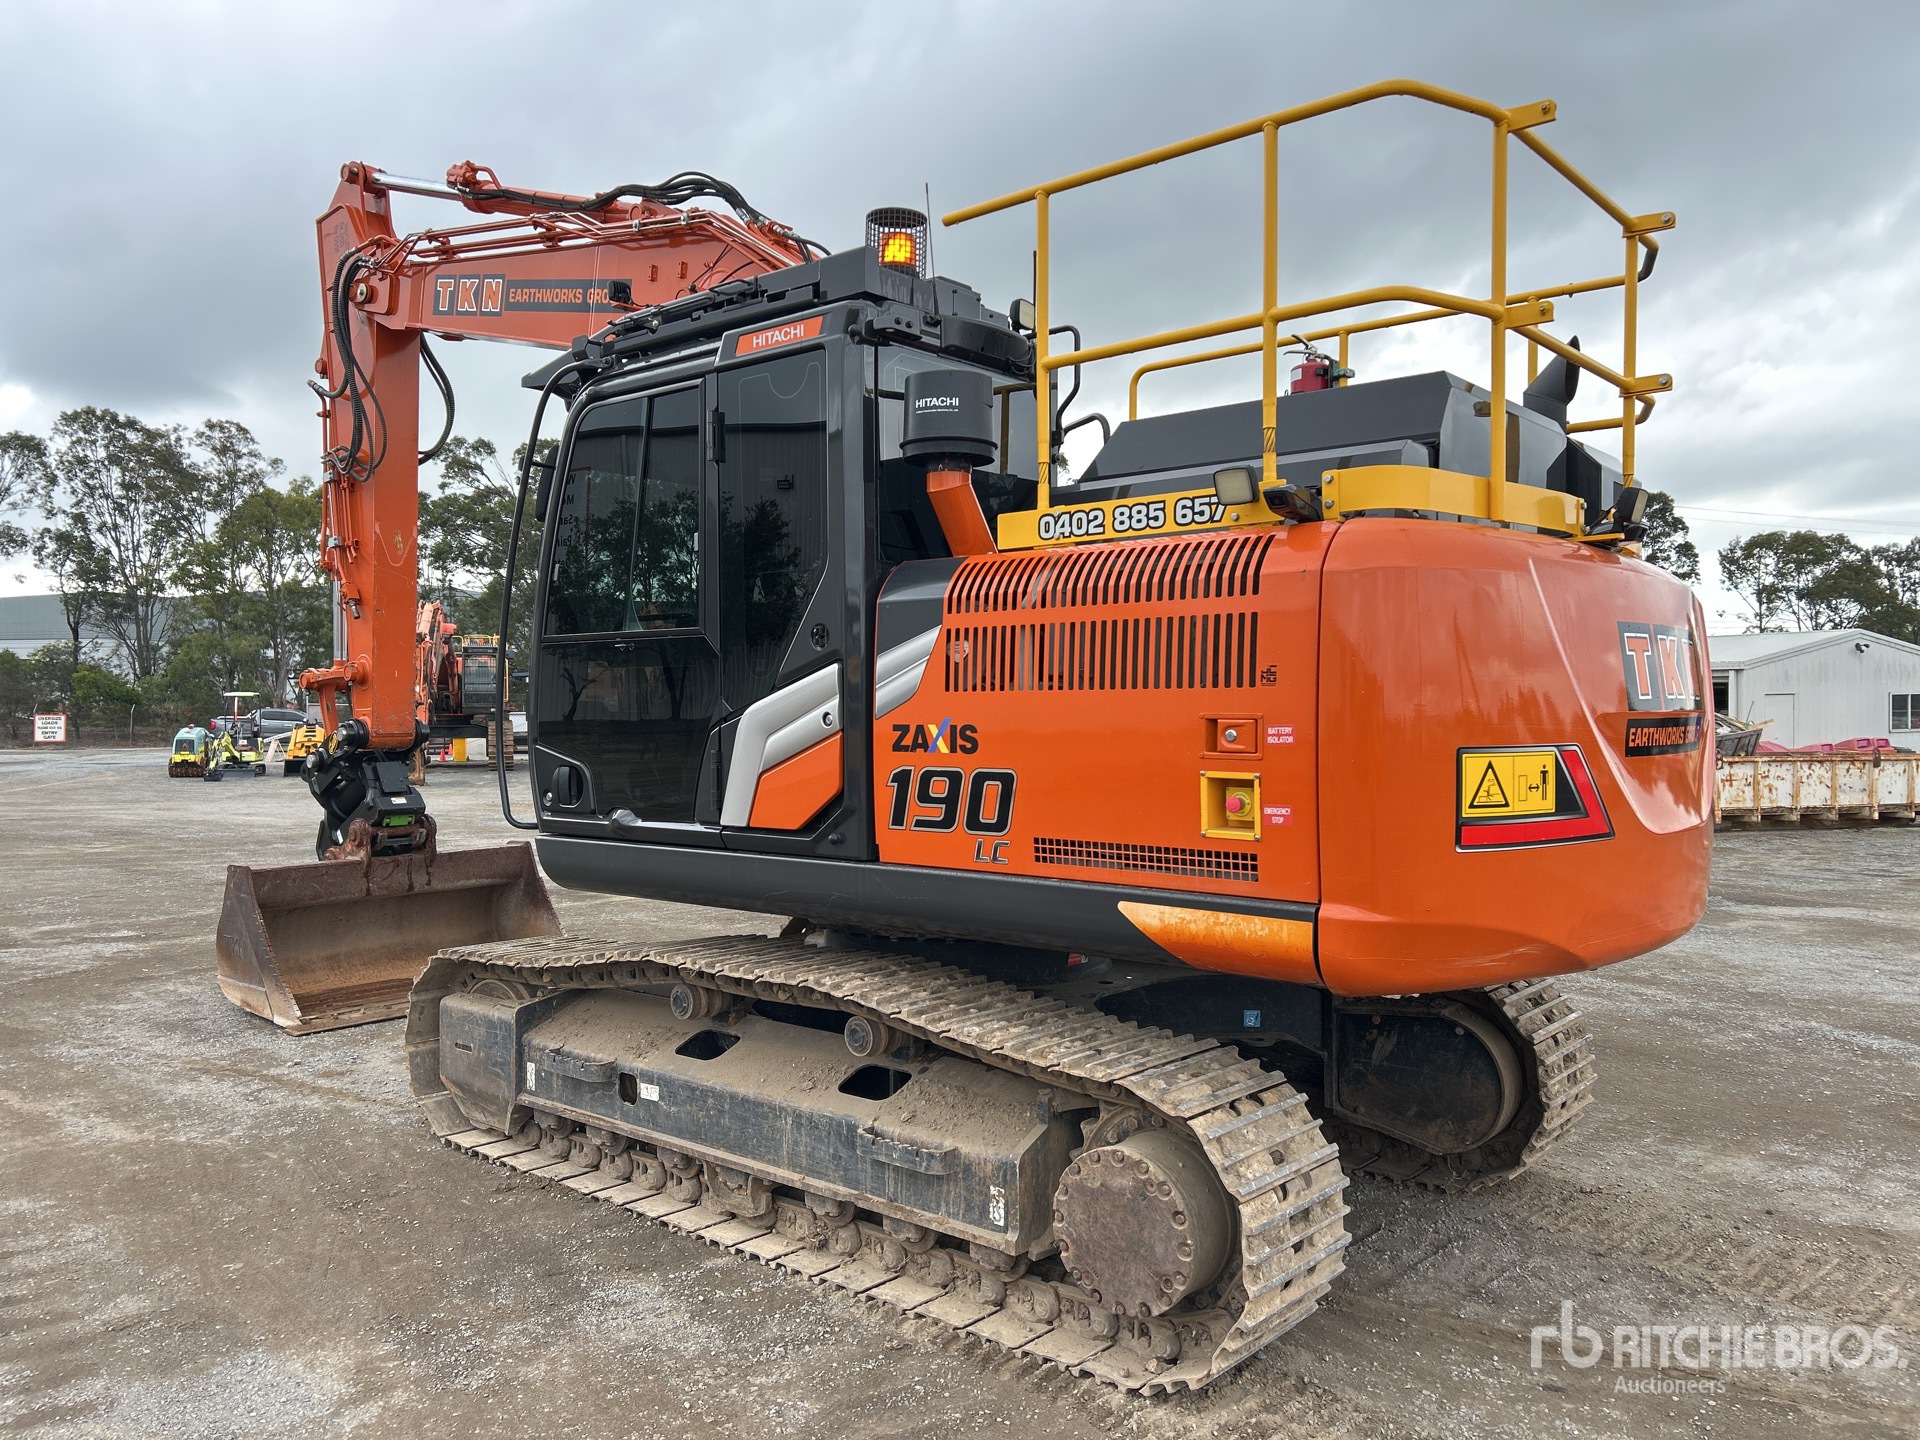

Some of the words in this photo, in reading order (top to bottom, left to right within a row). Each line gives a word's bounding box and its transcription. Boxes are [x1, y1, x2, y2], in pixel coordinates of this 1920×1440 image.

[437, 279, 503, 312] TKN
[509, 288, 583, 304] EARTHWORKS
[587, 289, 609, 304] GRO
[752, 324, 804, 348] HITACHI
[915, 397, 959, 409] HITACHI
[1039, 509, 1105, 540] 0402
[1112, 499, 1166, 532] 885
[1173, 494, 1228, 526] 657
[891, 717, 979, 755] ZAXIS
[1267, 727, 1292, 735] BATTERY
[1267, 736, 1294, 744] ISOLATOR
[1628, 725, 1685, 748] EARTHWORKS
[886, 765, 1018, 837] 190
[1263, 807, 1291, 816] EMERGENCY
[1271, 816, 1284, 824] STOP
[973, 838, 1011, 865] LC
